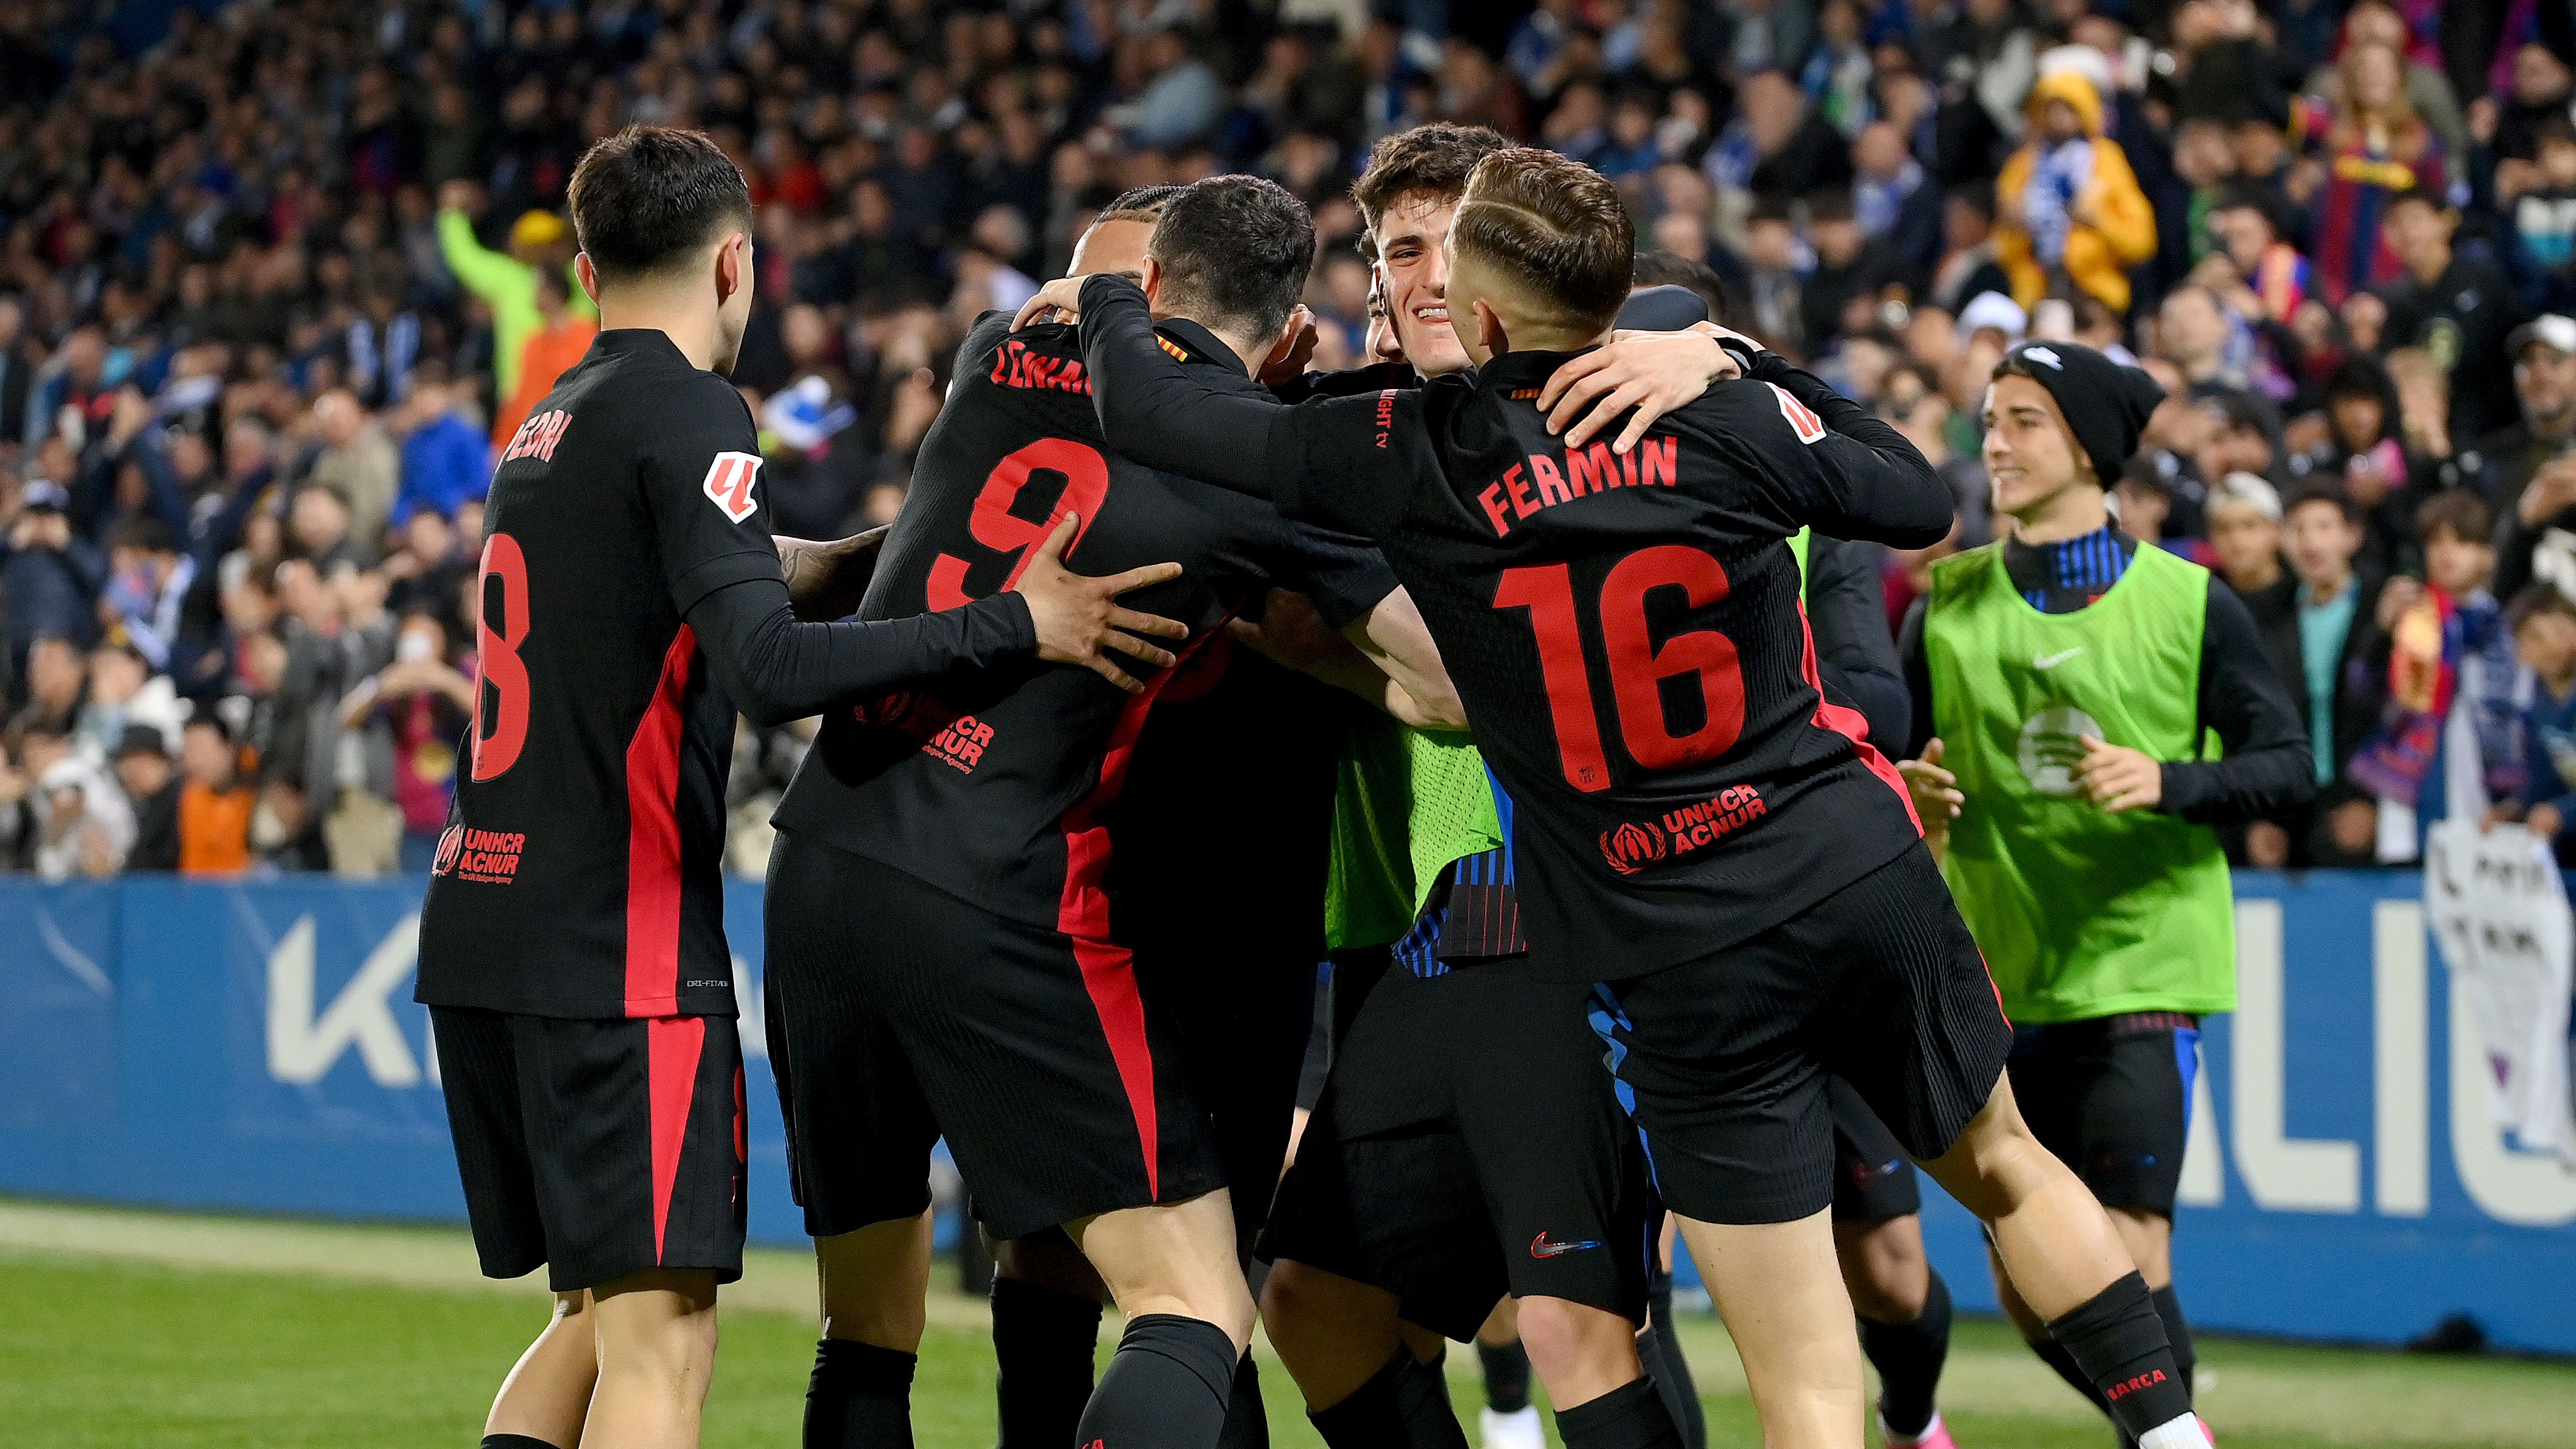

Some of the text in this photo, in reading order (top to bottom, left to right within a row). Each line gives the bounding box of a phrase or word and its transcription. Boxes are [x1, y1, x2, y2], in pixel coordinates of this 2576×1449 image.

[494, 409, 573, 474] EDRI
[1376, 431, 1389, 449] tv
[925, 437, 1110, 612] 9
[471, 532, 530, 782] 8
[1492, 544, 1746, 793] 16
[1663, 784, 1760, 833] UNHCR
[1675, 798, 1768, 855] ACNUR
[458, 850, 519, 875] ACNUR
[465, 827, 525, 854] UNHCR
